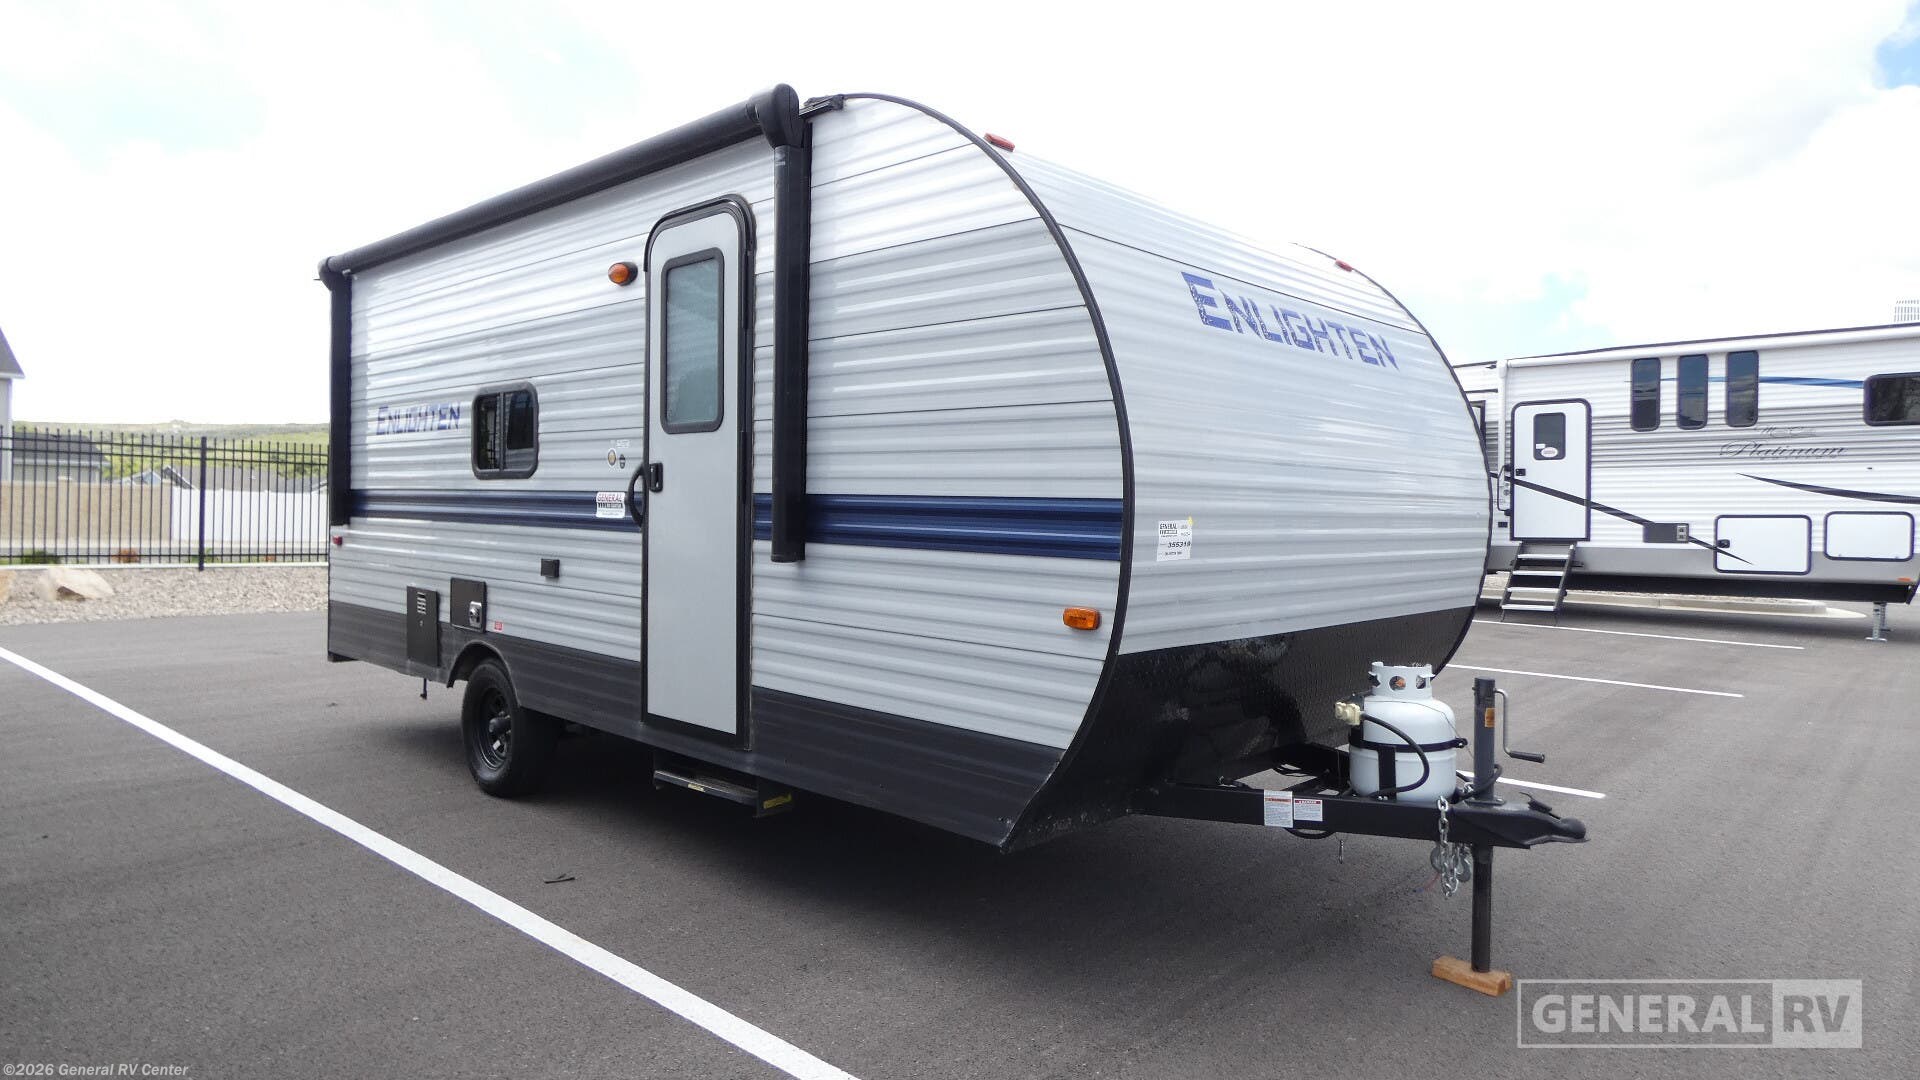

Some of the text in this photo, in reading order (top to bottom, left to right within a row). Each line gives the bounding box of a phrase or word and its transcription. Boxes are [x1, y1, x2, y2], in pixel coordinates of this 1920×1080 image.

[1181, 272, 1399, 370] ENLIGHTEN
[376, 402, 461, 435] ENLIGHTEN
[1719, 440, 1848, 458] Platinum
[597, 493, 622, 502] GENERAL
